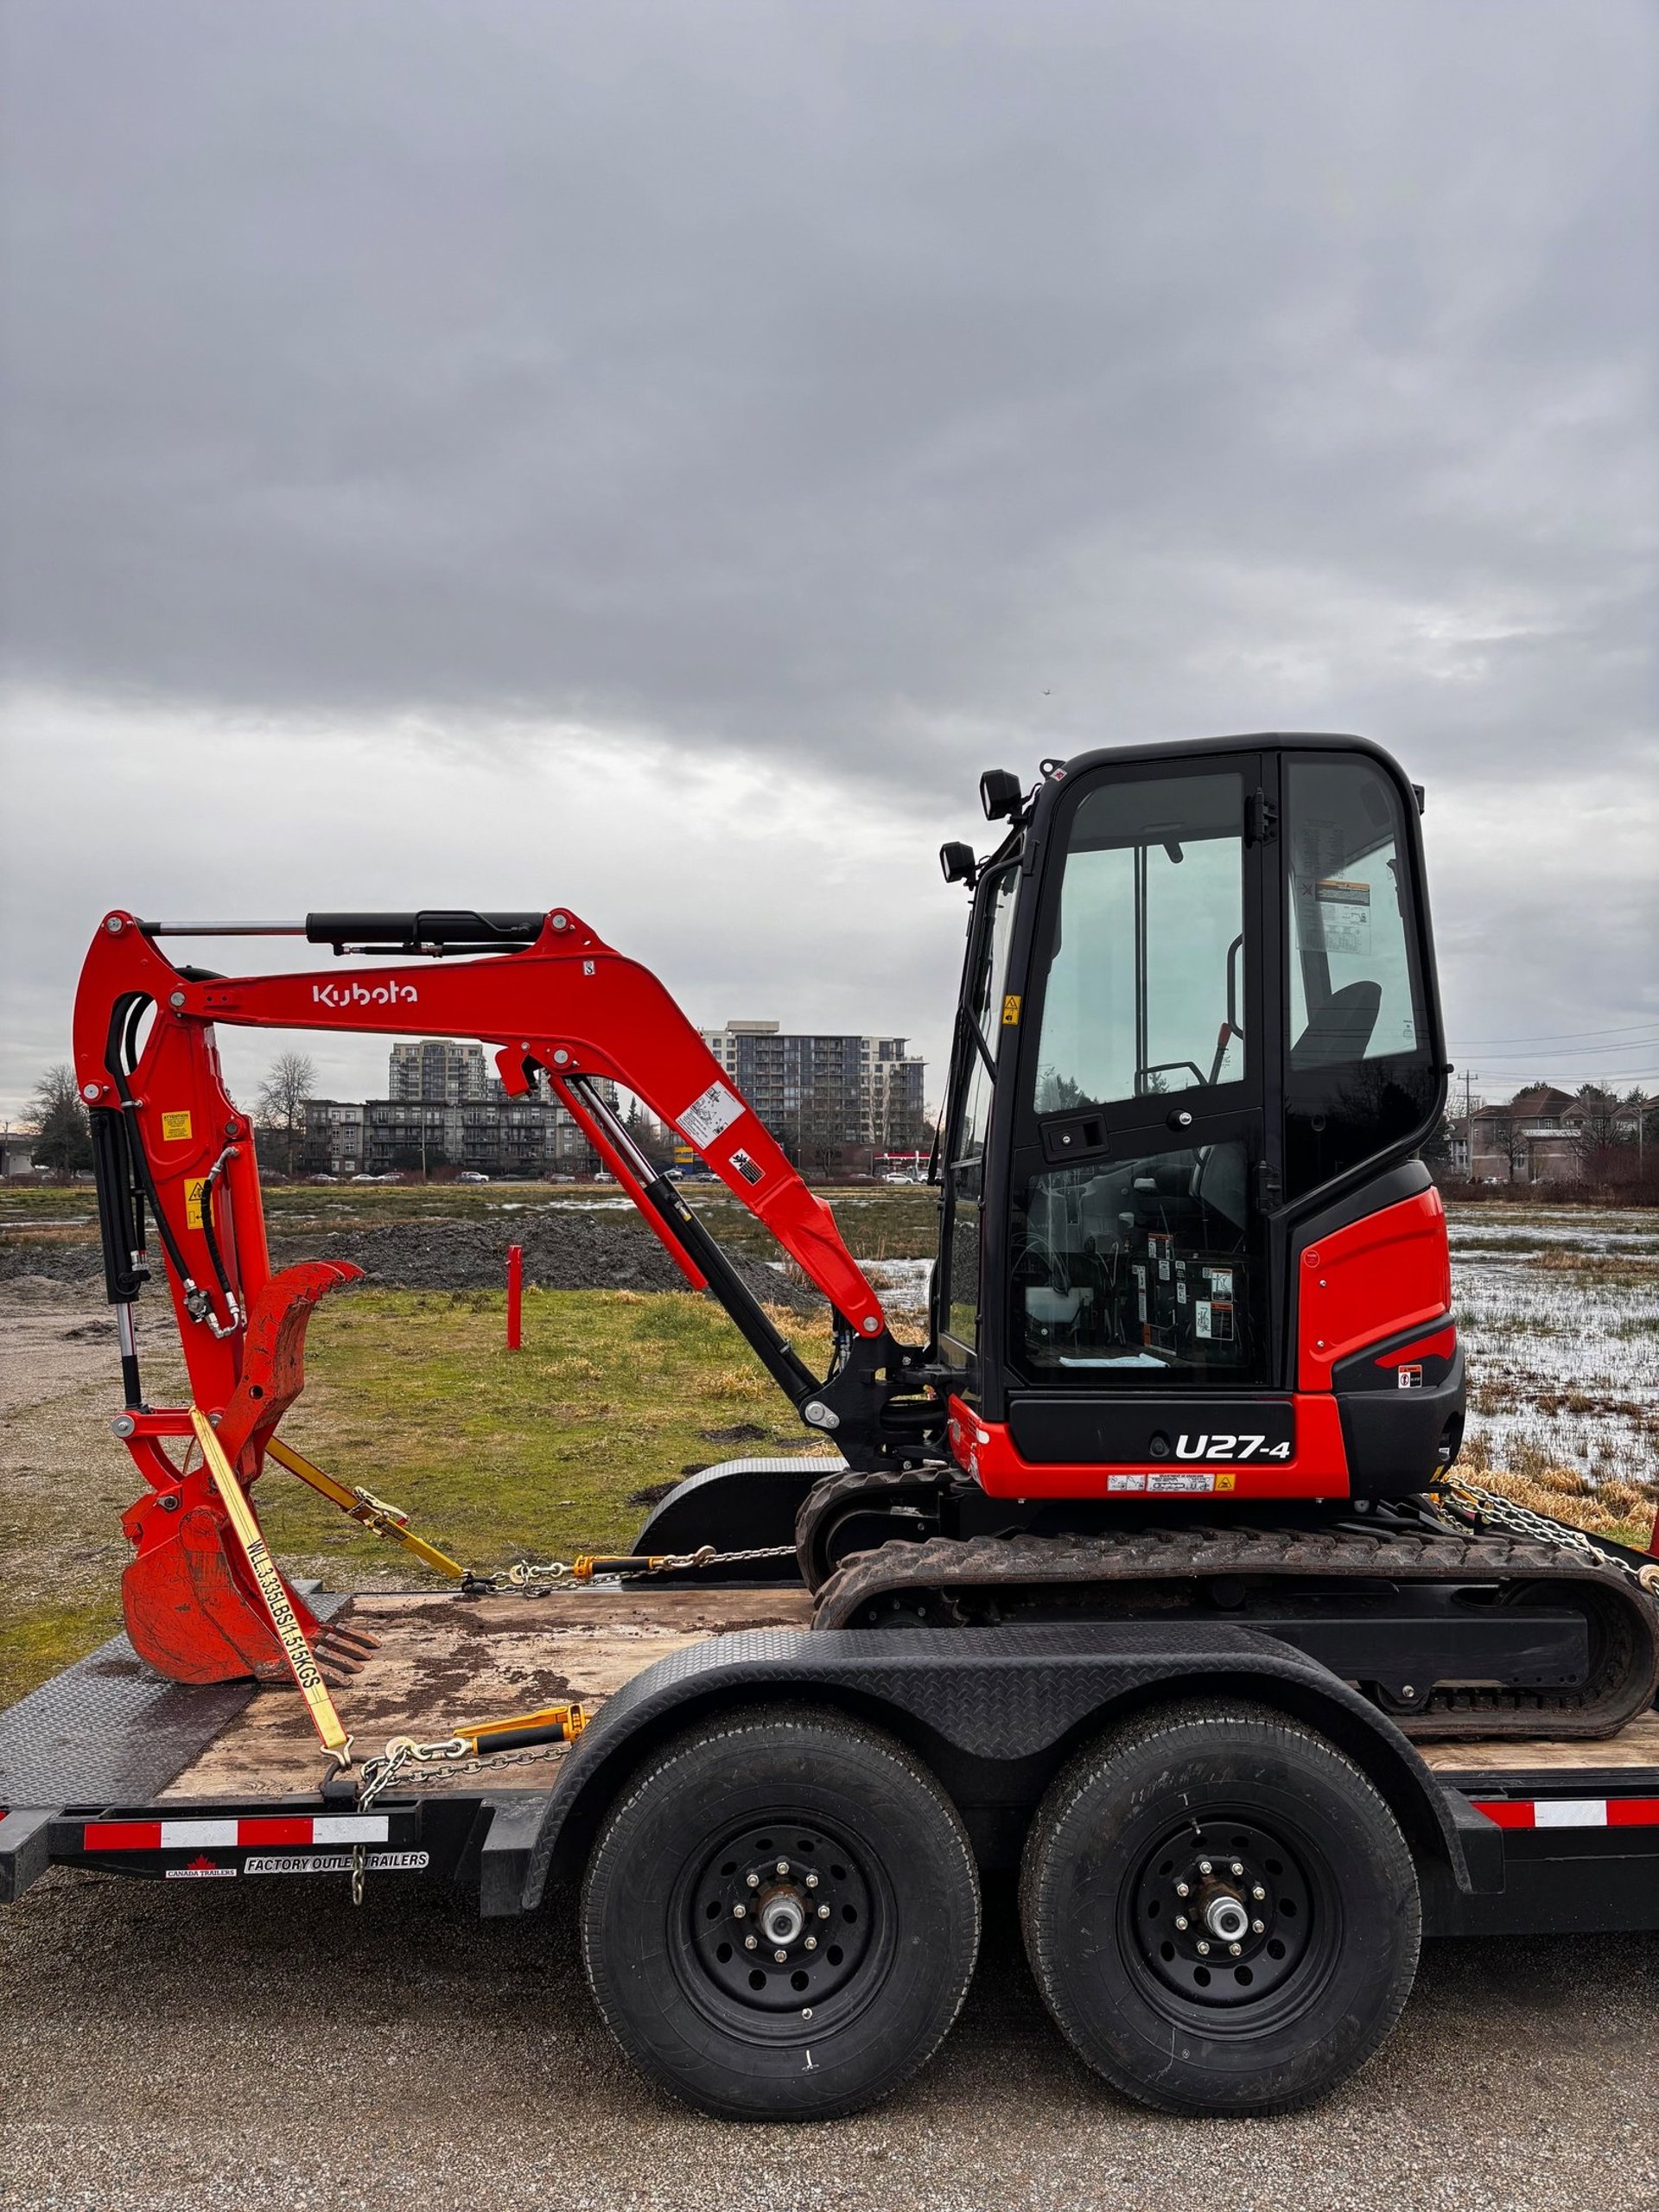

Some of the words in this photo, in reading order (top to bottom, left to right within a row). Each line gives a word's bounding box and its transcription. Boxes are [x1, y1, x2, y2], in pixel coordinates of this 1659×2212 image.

[312, 980, 418, 1007] Kubota
[1175, 1434, 1291, 1459] U27-4
[247, 1858, 309, 1871] FACTORY
[312, 1856, 361, 1868] OUTLE
[363, 1854, 428, 1867] TRAILERS
